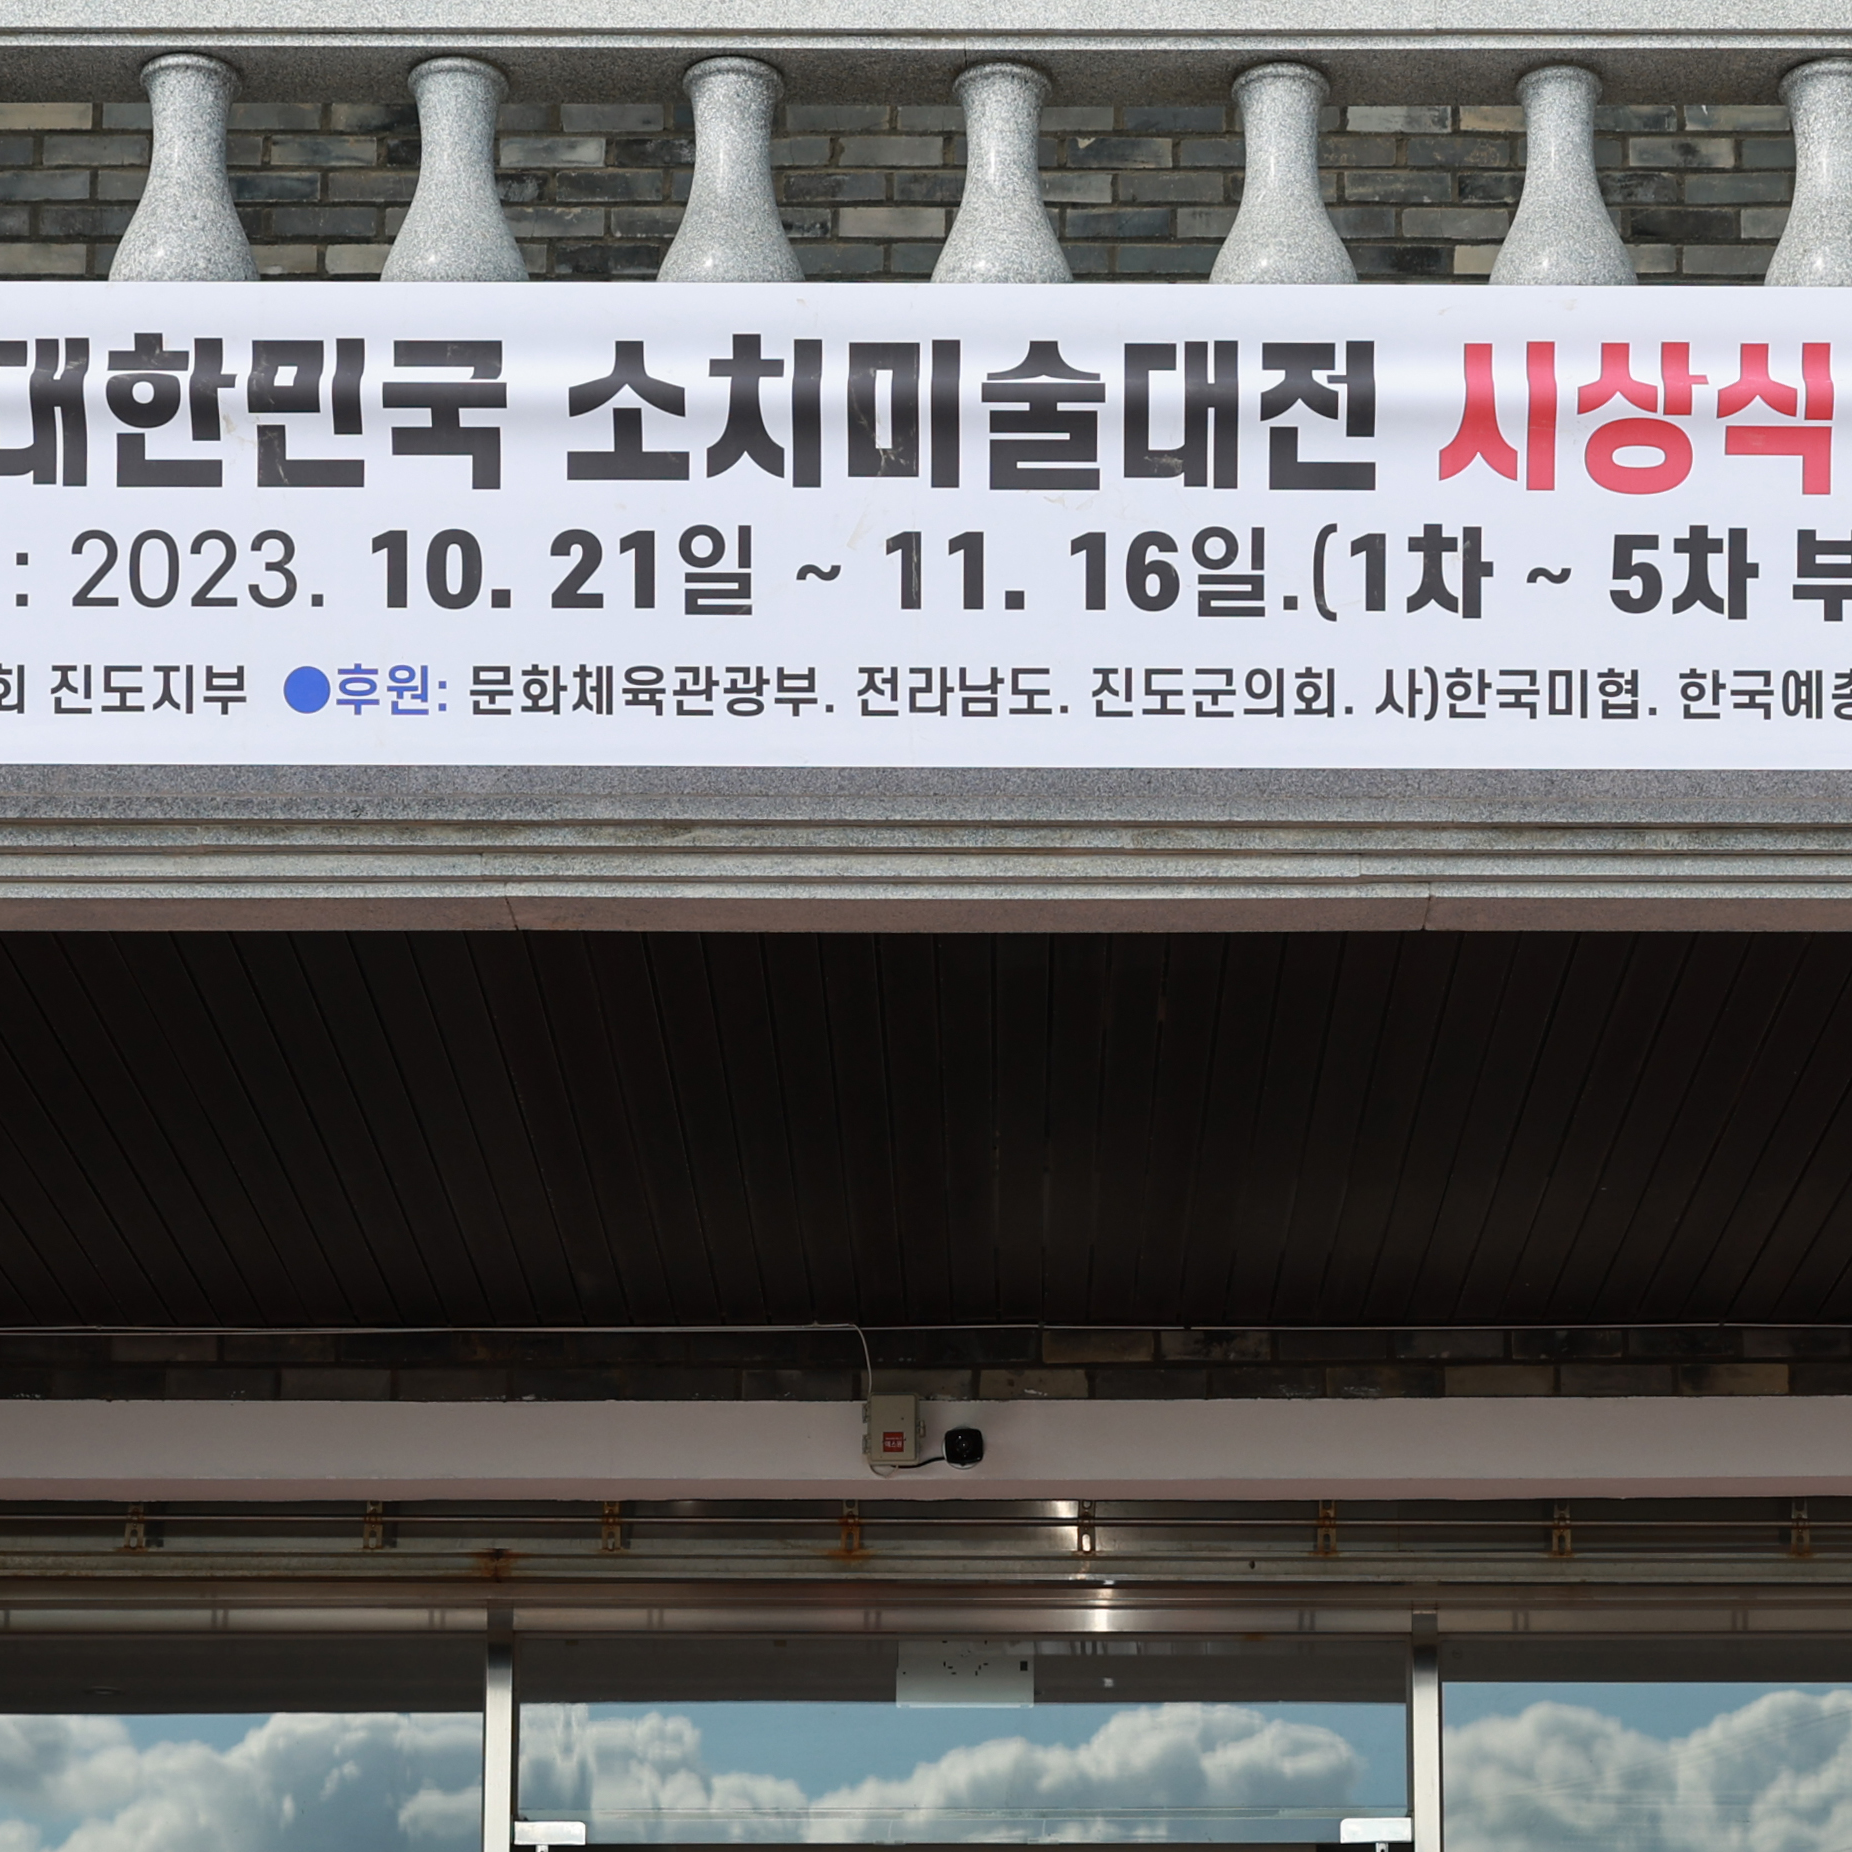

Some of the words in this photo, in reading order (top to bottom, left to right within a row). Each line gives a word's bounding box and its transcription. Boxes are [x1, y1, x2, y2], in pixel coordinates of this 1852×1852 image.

[567, 334, 1375, 490] 소치미술대전
[1439, 341, 1834, 495] 시상식
[72, 530, 324, 608] 2023.
[372, 529, 512, 609] 10.
[551, 525, 752, 615] 21일
[886, 531, 1025, 610] 11.
[1610, 525, 1759, 619] 5차
[50, 664, 247, 716] 진도지부
[334, 664, 447, 716] 후원:
[469, 664, 834, 717] 문화체육관광부.
[857, 666, 1069, 718] 전라남도.
[1091, 667, 1354, 719] 진도군의회.
[1375, 666, 1657, 721] 사)한국미협.
